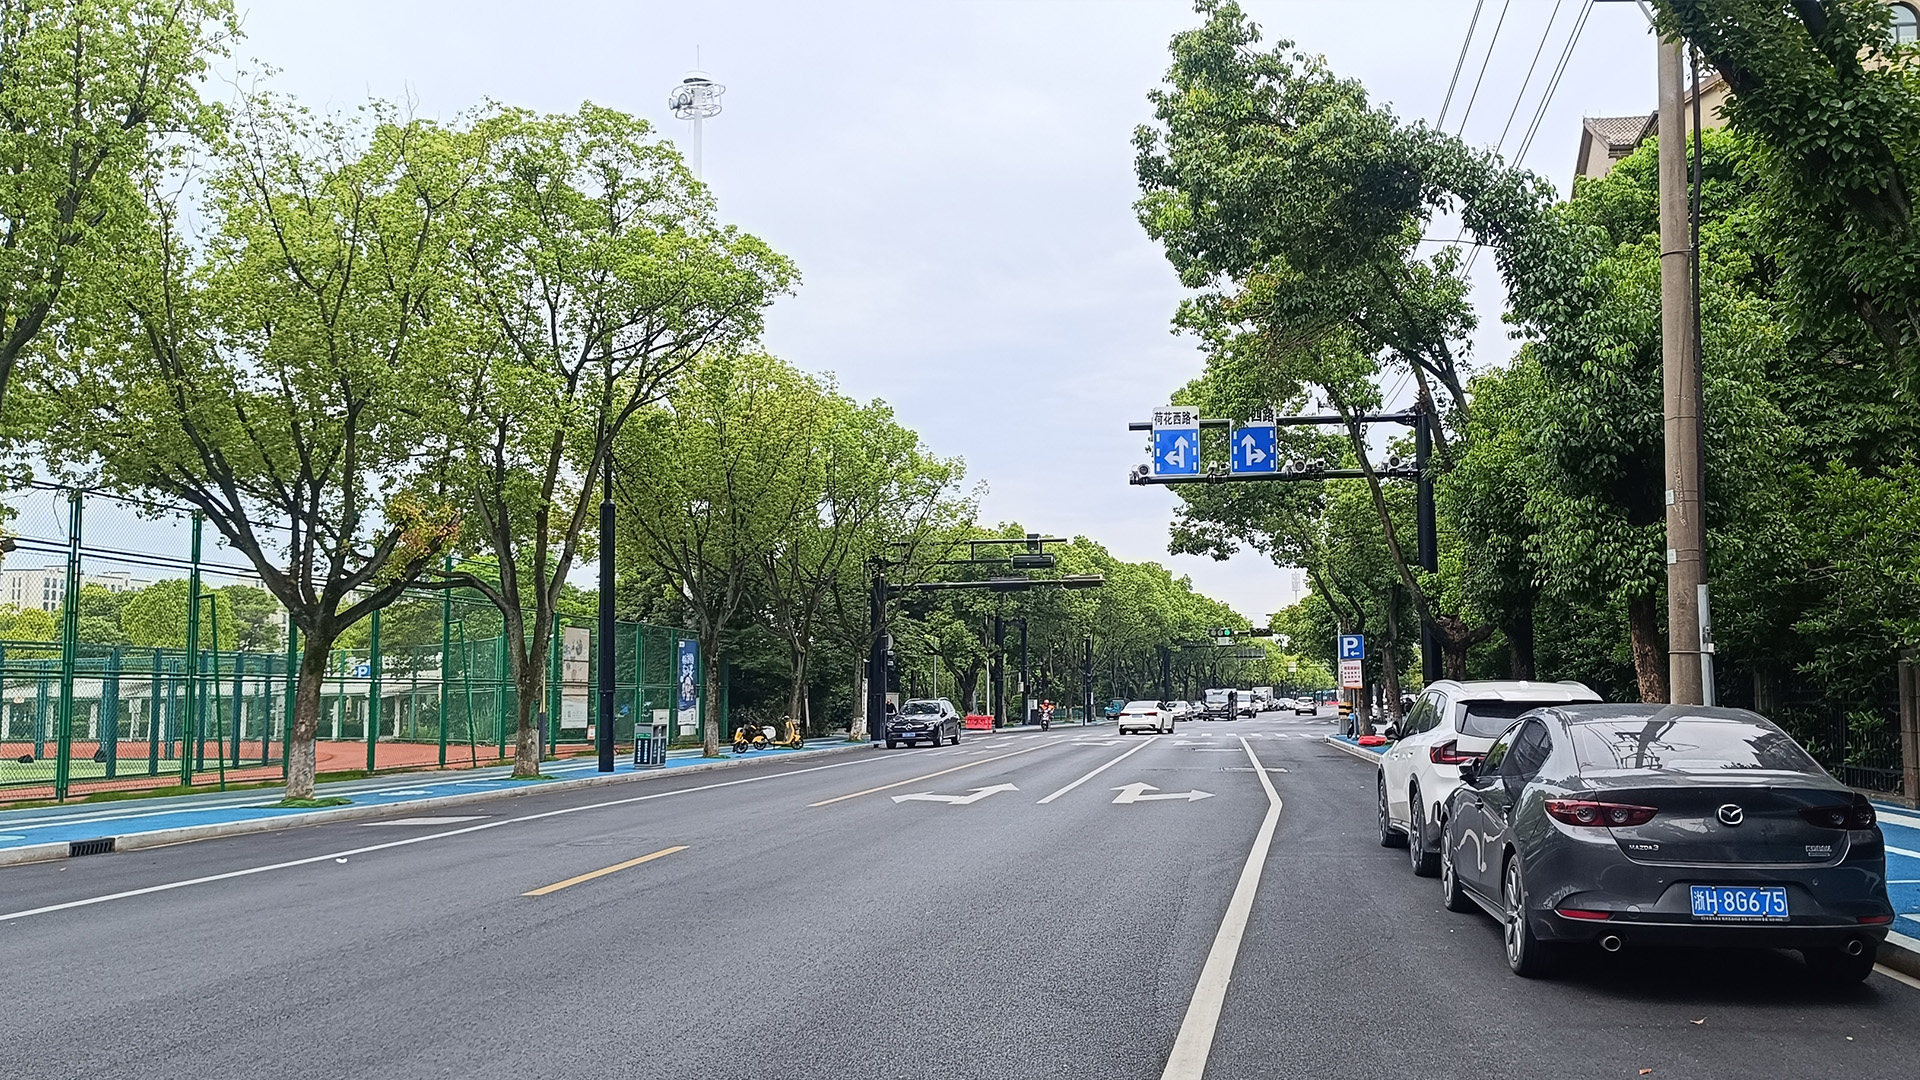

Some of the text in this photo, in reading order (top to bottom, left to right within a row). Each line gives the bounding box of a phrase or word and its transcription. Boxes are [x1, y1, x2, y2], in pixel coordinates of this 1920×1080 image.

[1154, 411, 1191, 425] 荷花西路
[1251, 408, 1274, 422] 西路
[1343, 637, 1358, 657] P
[357, 666, 368, 678] P
